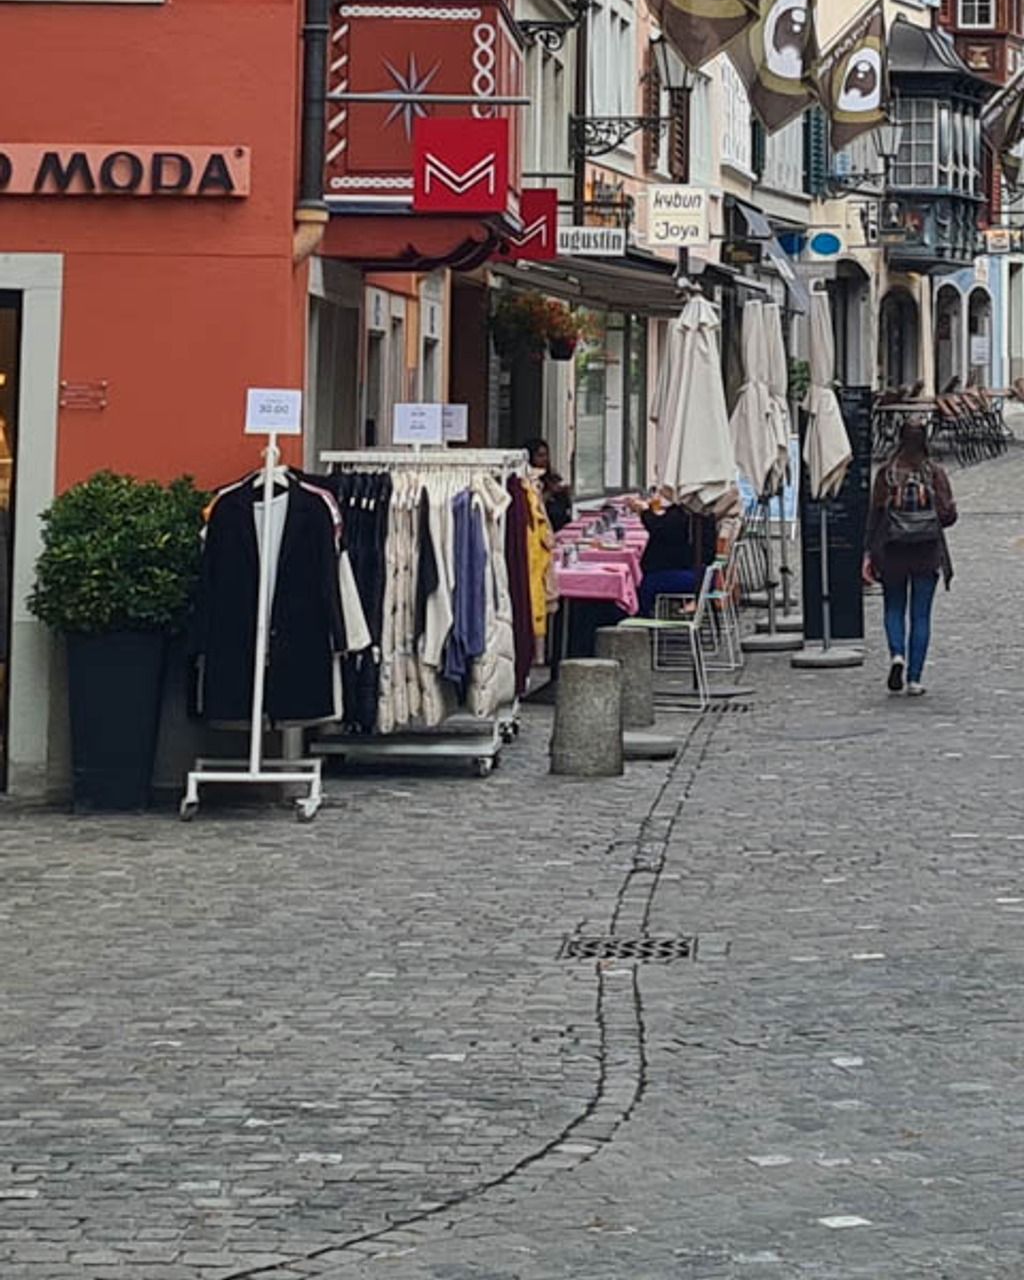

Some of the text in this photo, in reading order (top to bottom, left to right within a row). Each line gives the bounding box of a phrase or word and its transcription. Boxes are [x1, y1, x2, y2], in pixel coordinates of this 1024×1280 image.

[33, 151, 236, 193] MODA
[558, 230, 622, 252] ugustin
[655, 221, 700, 241] Joya
